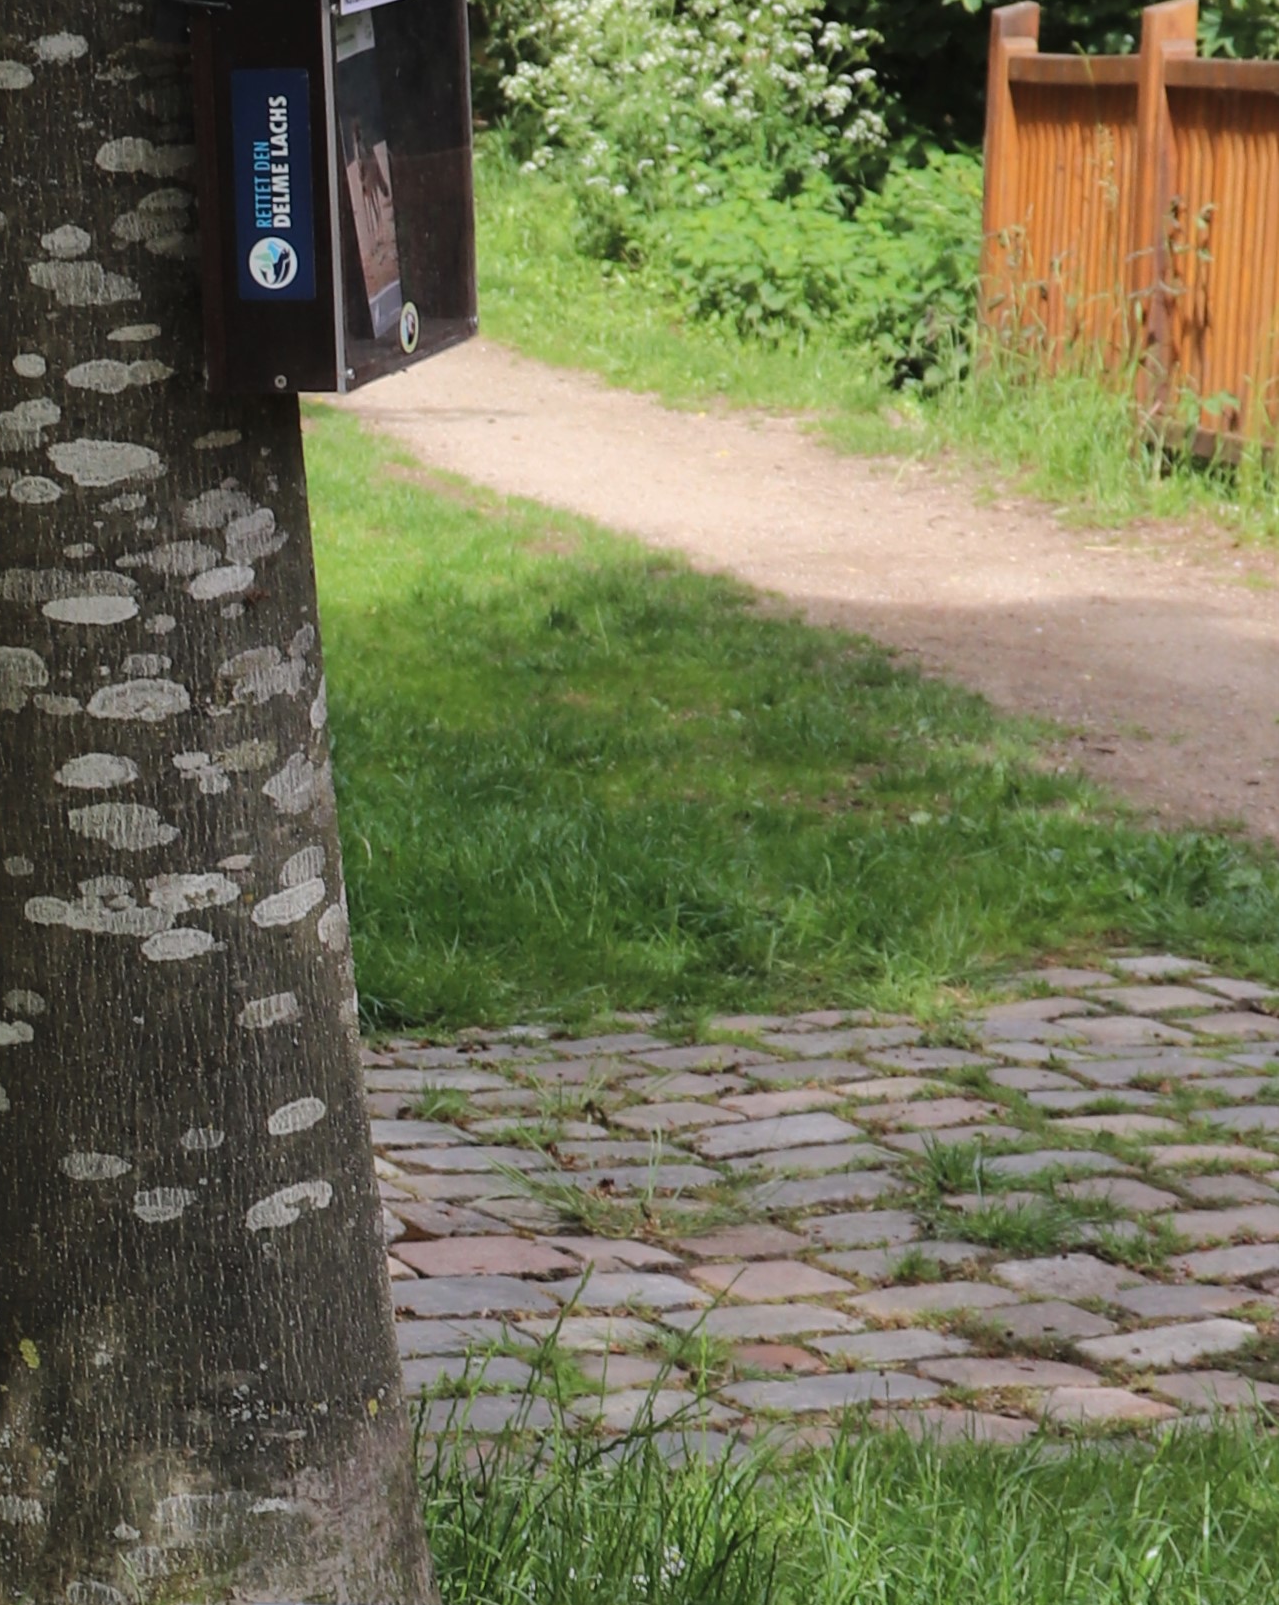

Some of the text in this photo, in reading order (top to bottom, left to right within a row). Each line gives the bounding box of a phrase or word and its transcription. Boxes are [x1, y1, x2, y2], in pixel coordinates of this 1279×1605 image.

[253, 141, 273, 228] RETTET DEN
[268, 95, 291, 228] DELME LACHS
